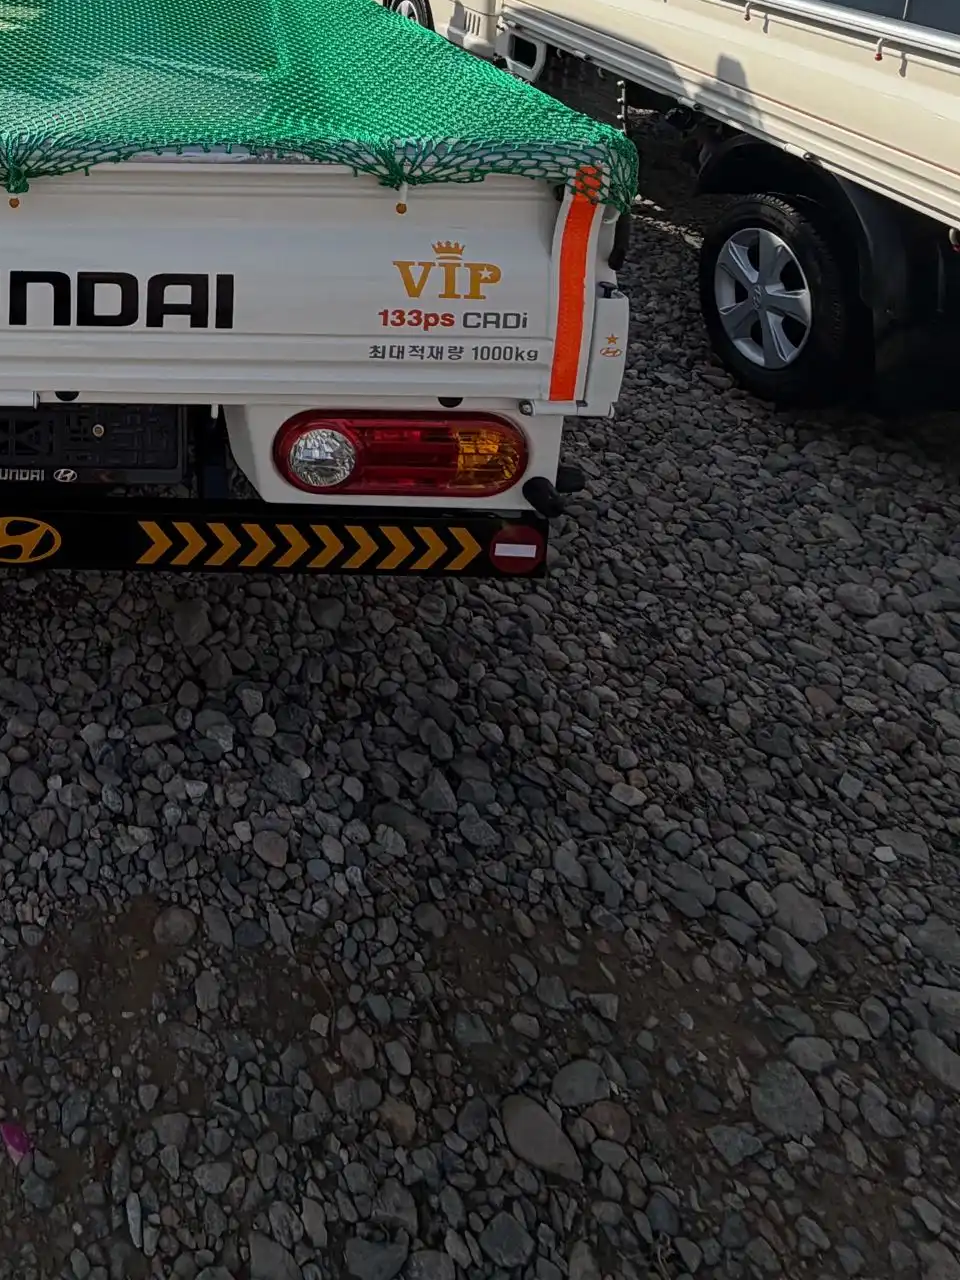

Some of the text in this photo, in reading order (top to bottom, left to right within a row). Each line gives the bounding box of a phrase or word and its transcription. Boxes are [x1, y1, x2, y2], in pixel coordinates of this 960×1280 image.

[392, 261, 502, 300] VIP
[378, 309, 455, 331] 133ps
[369, 345, 538, 361] 최대적재량 1000kg
